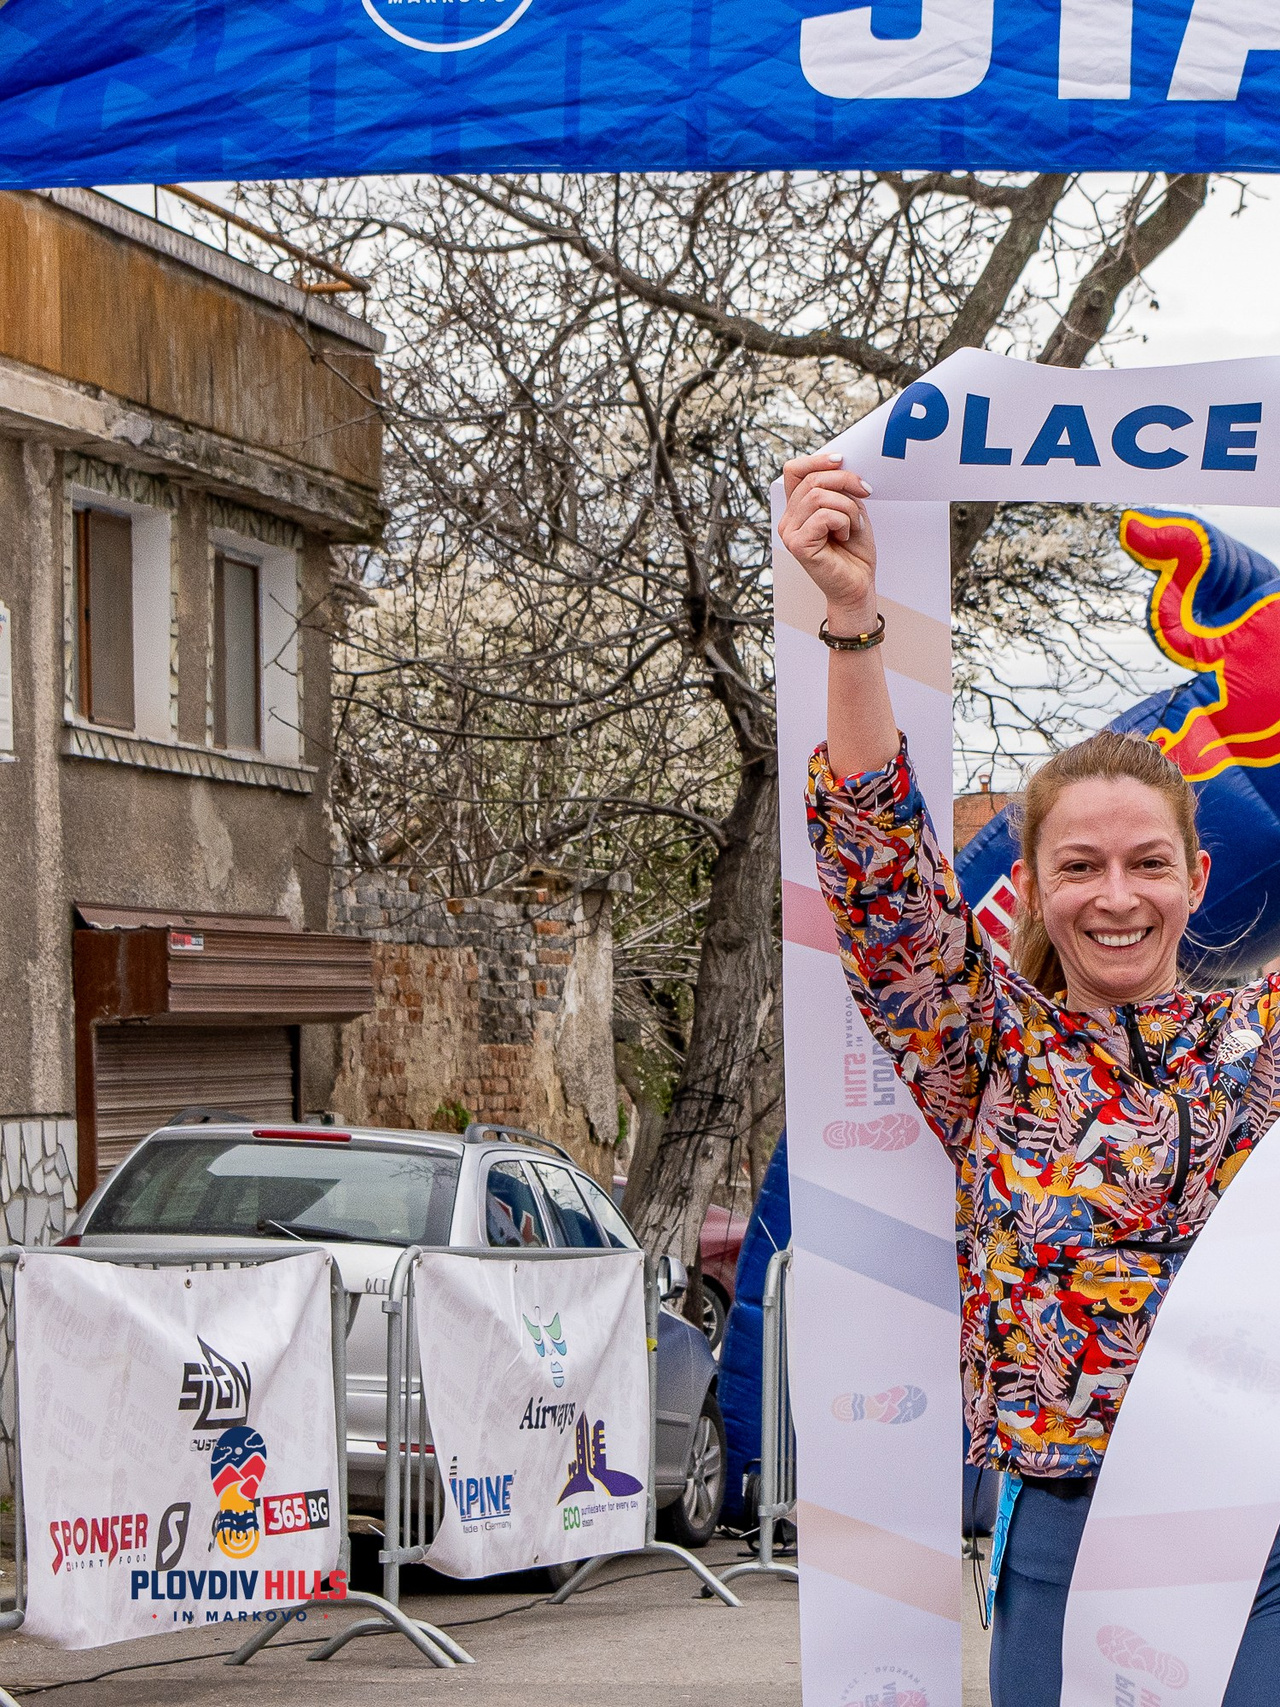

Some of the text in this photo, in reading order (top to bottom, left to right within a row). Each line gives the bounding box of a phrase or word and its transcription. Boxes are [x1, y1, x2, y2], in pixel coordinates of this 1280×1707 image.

[881, 382, 1262, 471] PLACE
[519, 1396, 576, 1434] Airways
[268, 1497, 329, 1531] 365.BG
[563, 1506, 580, 1530] ECO
[50, 1513, 149, 1576] SPONSER
[119, 1554, 147, 1565] FOOD
